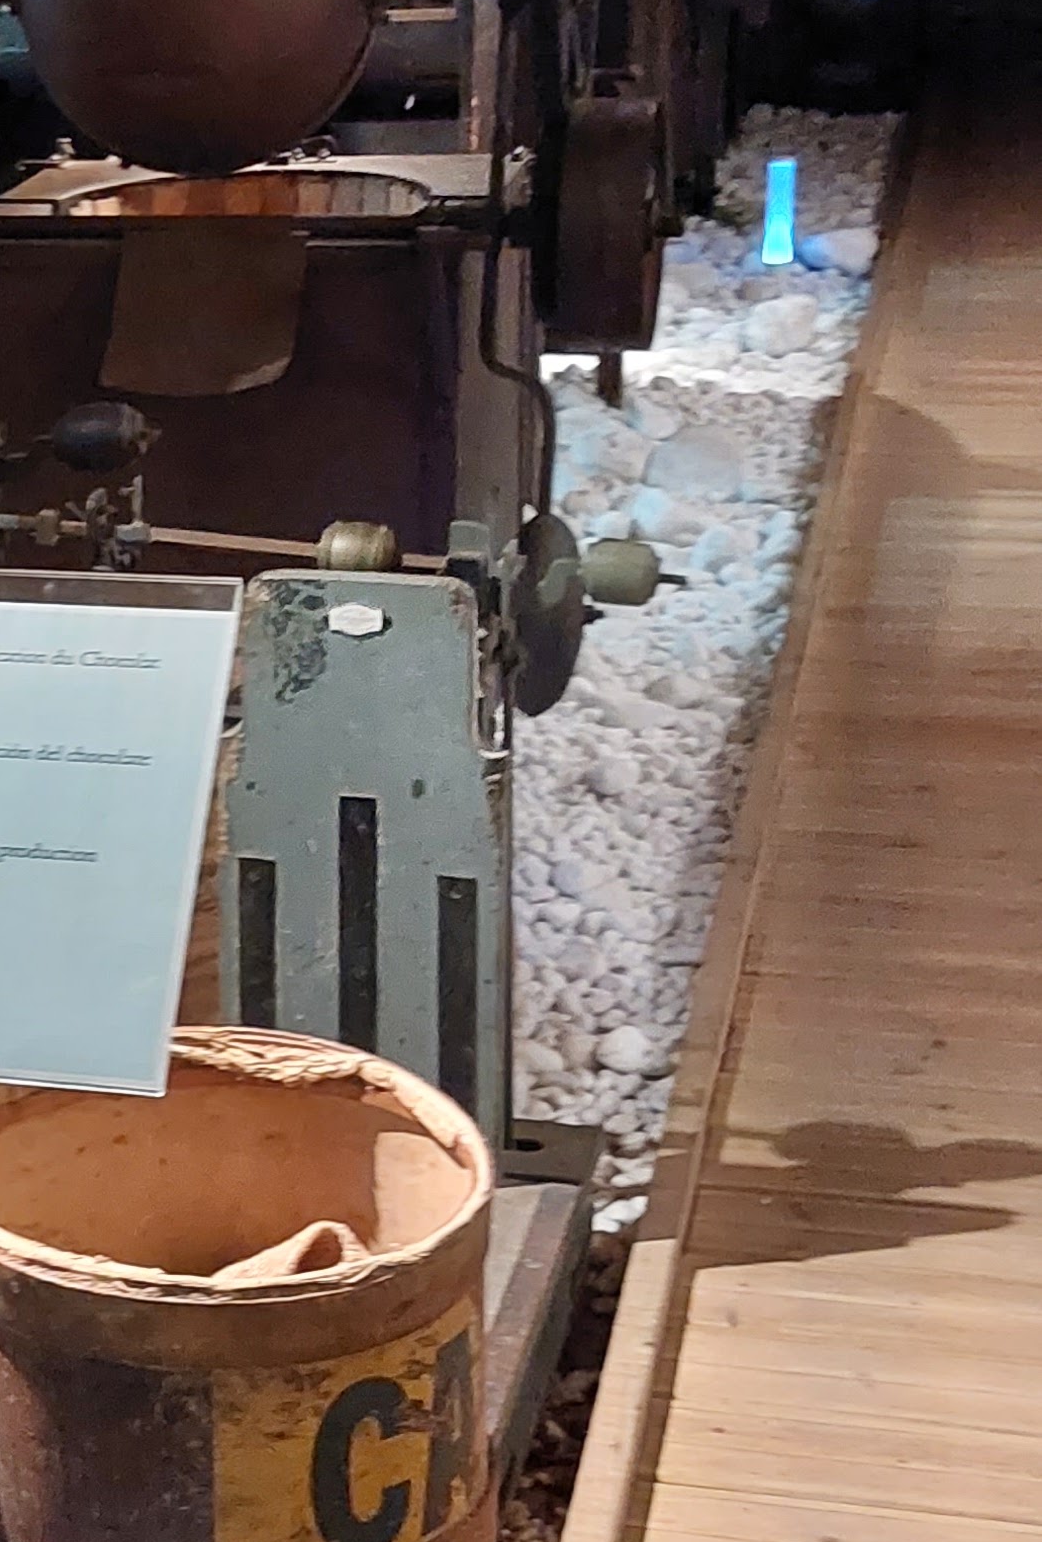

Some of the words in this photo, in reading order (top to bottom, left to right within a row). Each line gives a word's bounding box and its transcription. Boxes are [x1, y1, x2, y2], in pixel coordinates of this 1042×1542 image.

[50, 649, 76, 666] du
[35, 744, 64, 761] del
[66, 746, 153, 767] chocolate
